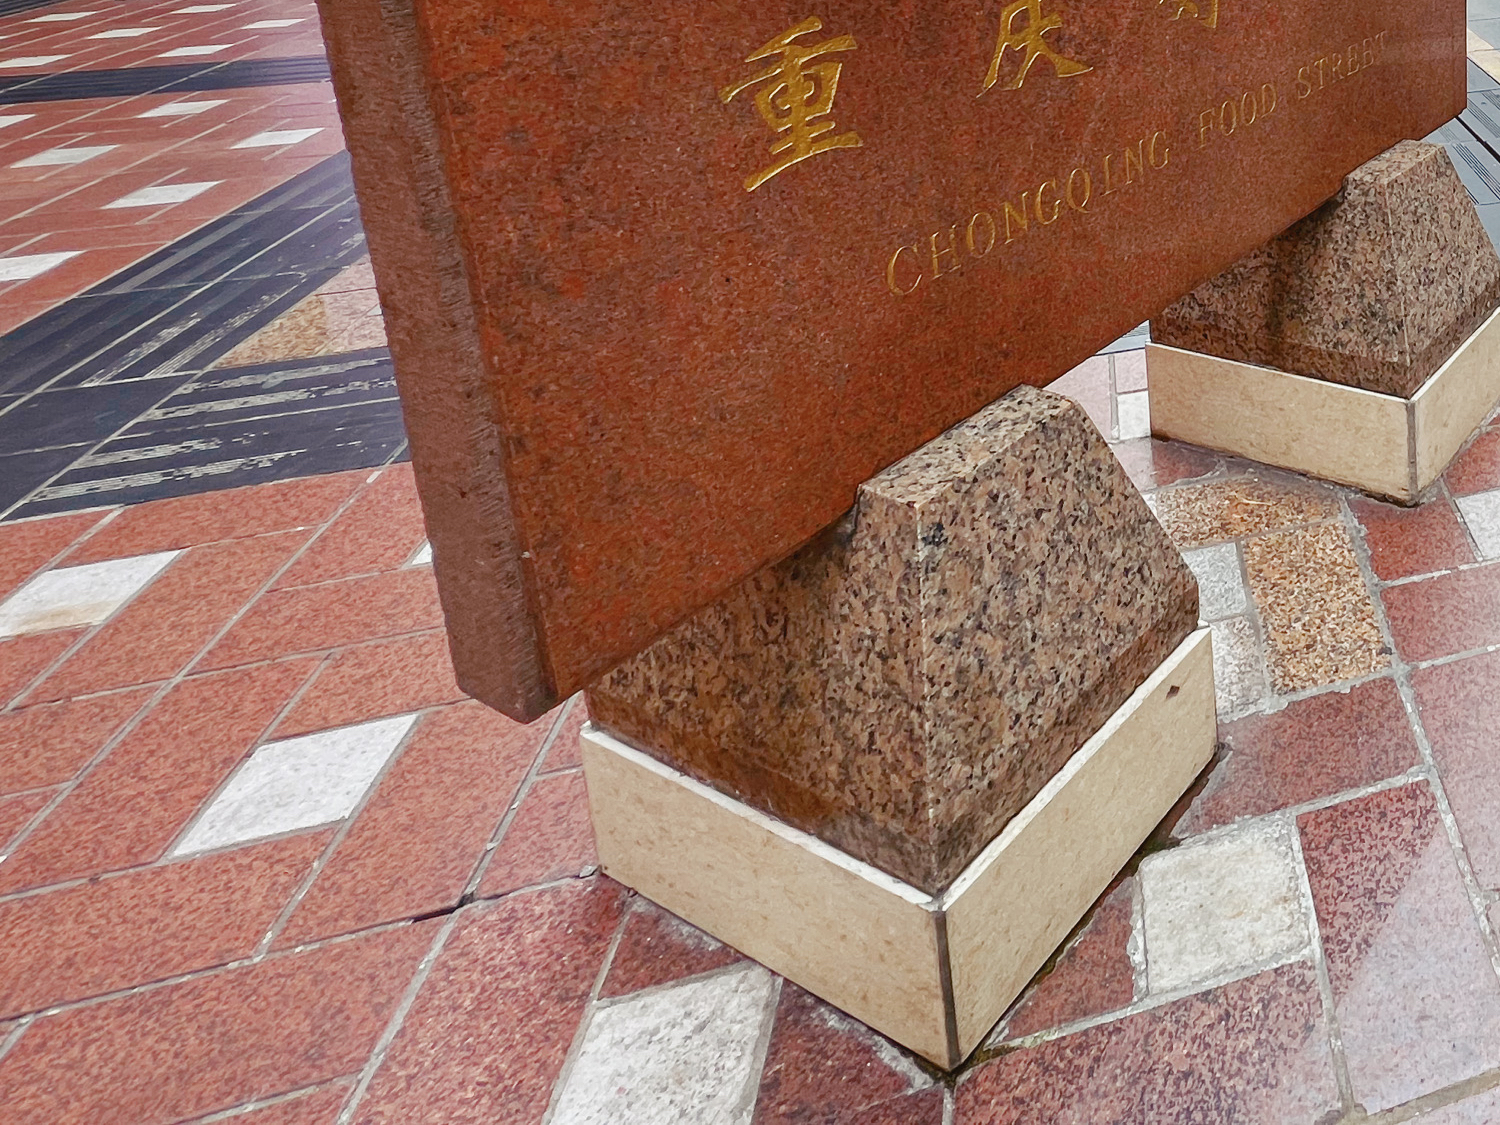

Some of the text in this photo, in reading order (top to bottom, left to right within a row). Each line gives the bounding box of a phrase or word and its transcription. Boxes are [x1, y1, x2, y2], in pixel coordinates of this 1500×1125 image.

[884, 29, 1388, 296] CHONGQING FOOD STREET
